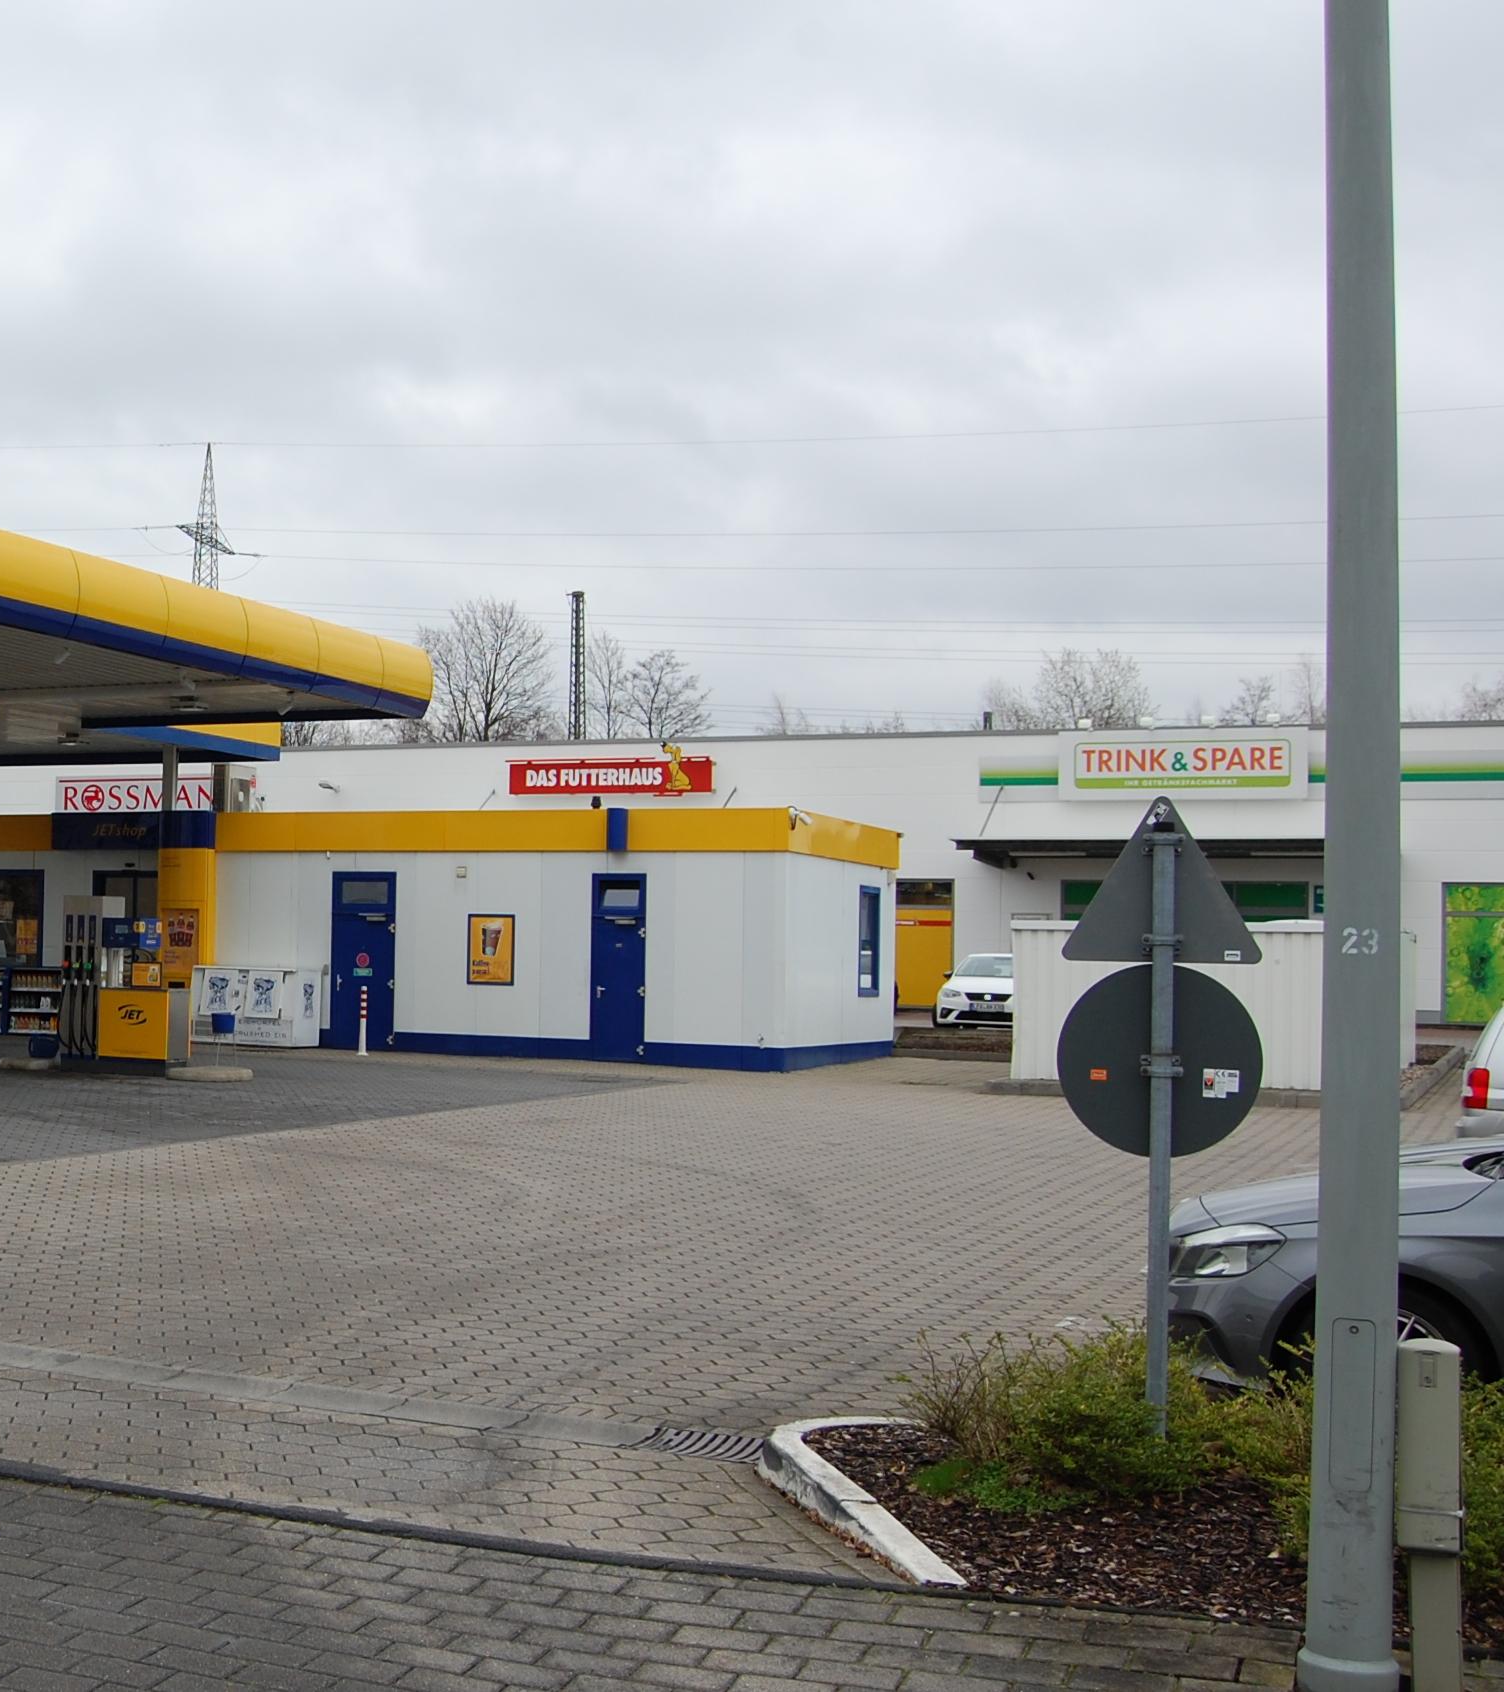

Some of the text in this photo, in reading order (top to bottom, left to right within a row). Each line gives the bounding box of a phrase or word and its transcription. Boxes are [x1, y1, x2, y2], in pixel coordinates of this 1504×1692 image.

[525, 766, 663, 787] DAS FUTTERHAUS
[63, 784, 214, 812] ROSSMAN
[1341, 927, 1379, 955] 23
[120, 1010, 144, 1021] JET
